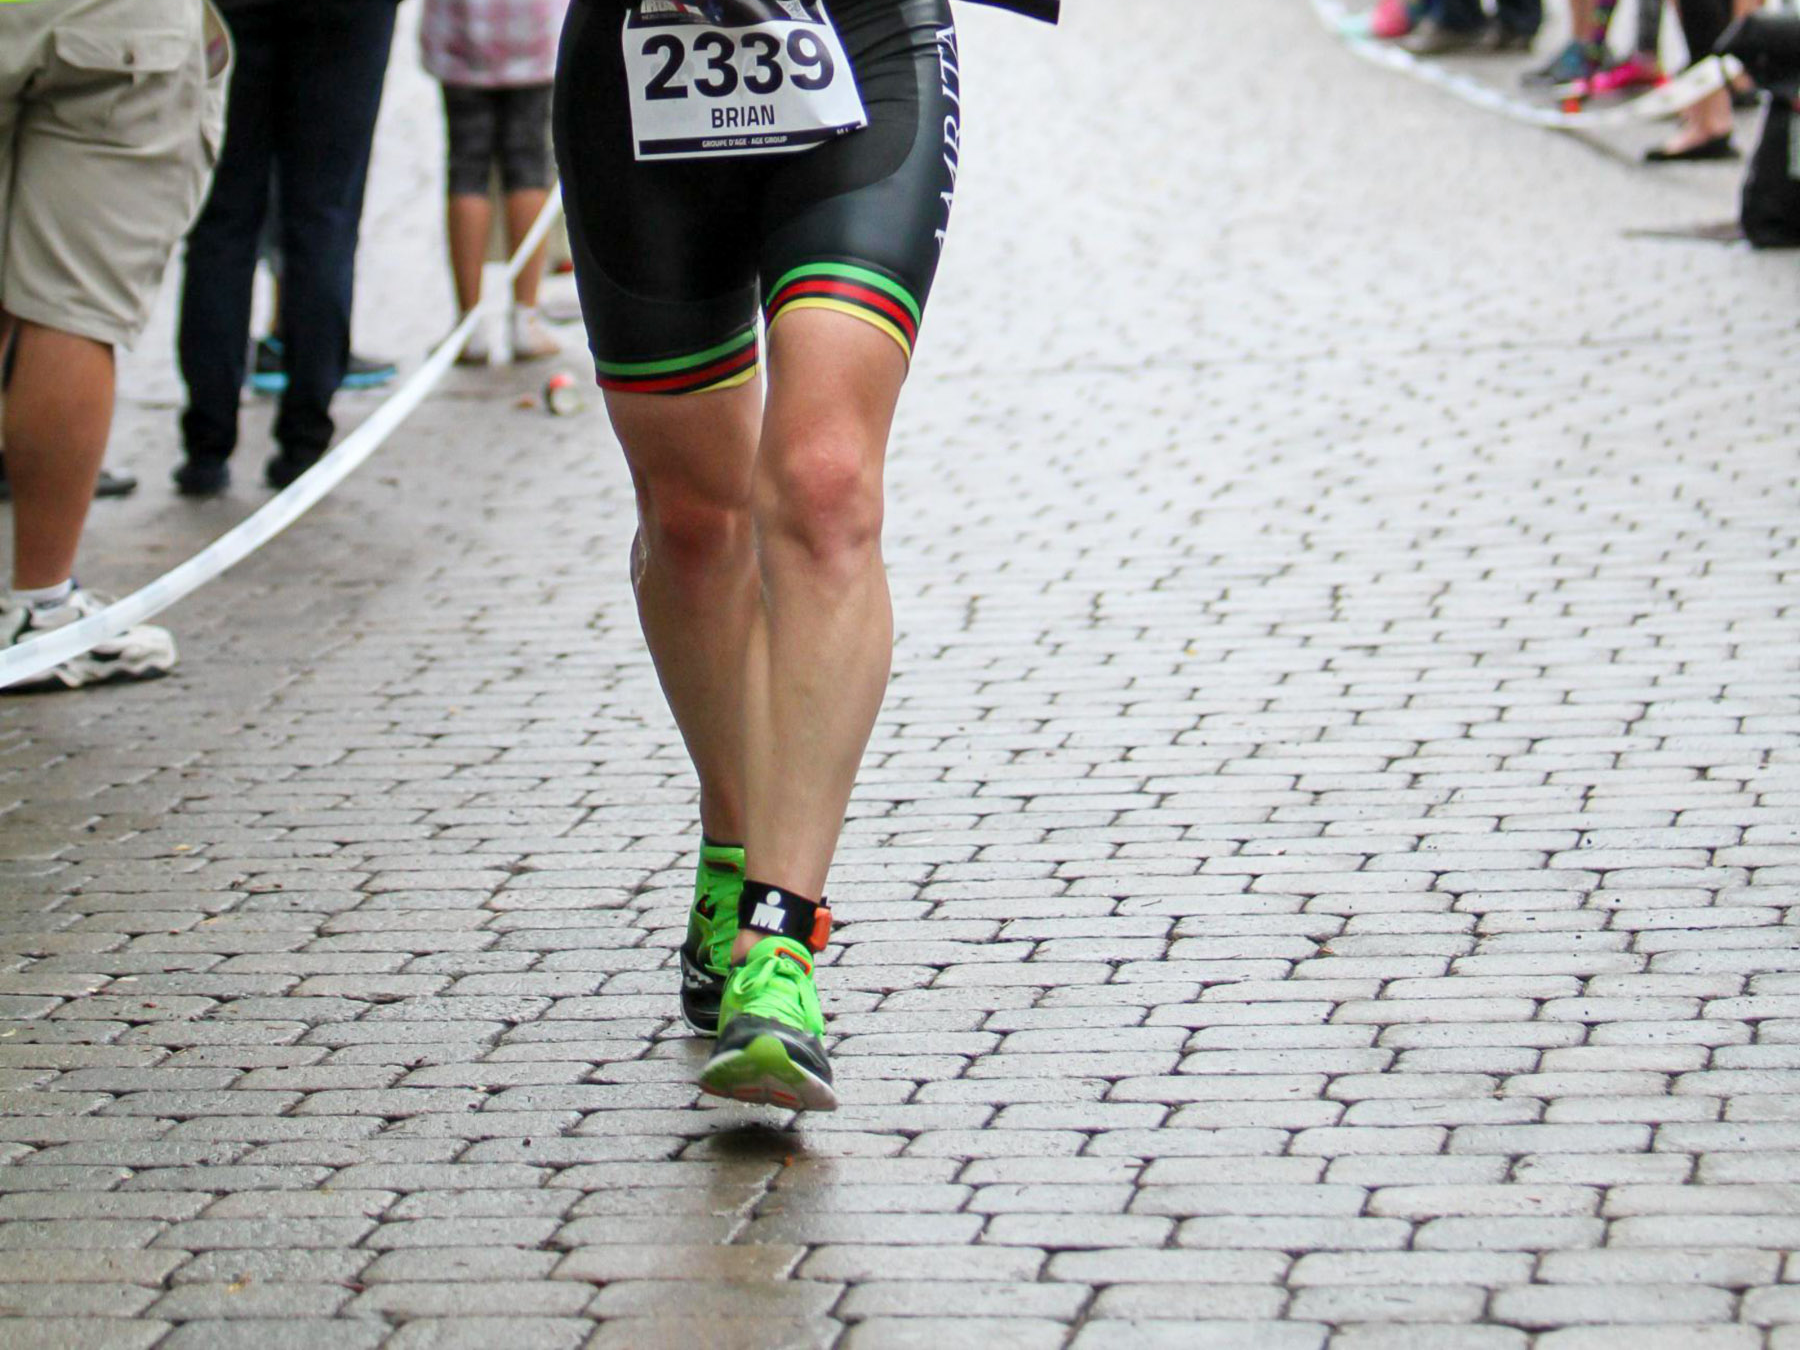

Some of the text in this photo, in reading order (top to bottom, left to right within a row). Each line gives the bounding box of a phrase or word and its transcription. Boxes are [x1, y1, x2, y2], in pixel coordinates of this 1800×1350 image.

[641, 28, 834, 101] 2339
[710, 104, 775, 129] BRIAN
[701, 138, 728, 148] GROUPE
[751, 136, 764, 146] AGE
[765, 135, 788, 145] GROUP
